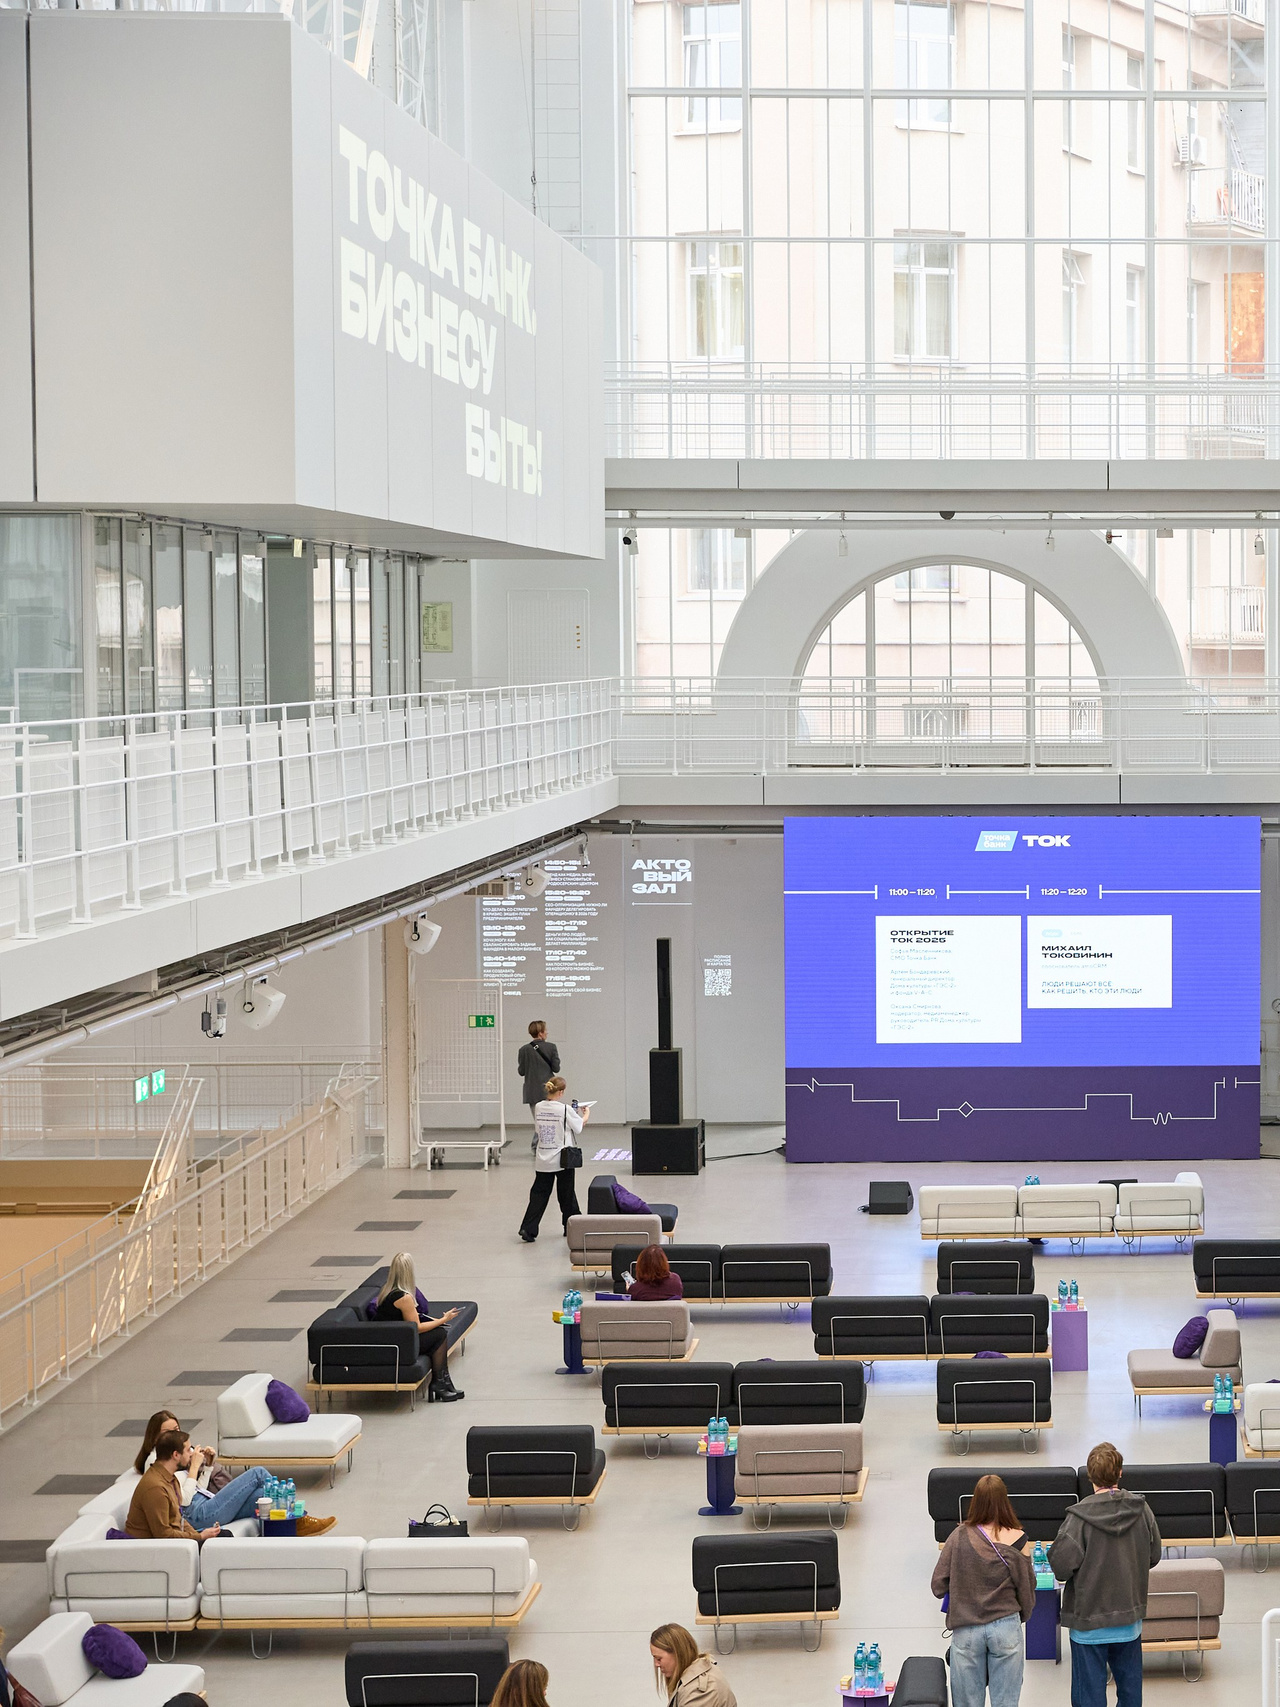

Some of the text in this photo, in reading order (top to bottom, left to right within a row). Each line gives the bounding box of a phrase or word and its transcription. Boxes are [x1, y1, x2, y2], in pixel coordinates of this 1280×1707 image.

[339, 123, 460, 289] ТОЧКА
[340, 236, 498, 396] БИЗНЕСУ
[465, 402, 543, 497] БЫТЬ!
[1022, 835, 1071, 847] ТОК
[632, 859, 691, 870] АКТО
[643, 869, 692, 882] ВЫЙ
[632, 883, 676, 894] ЗАЛ
